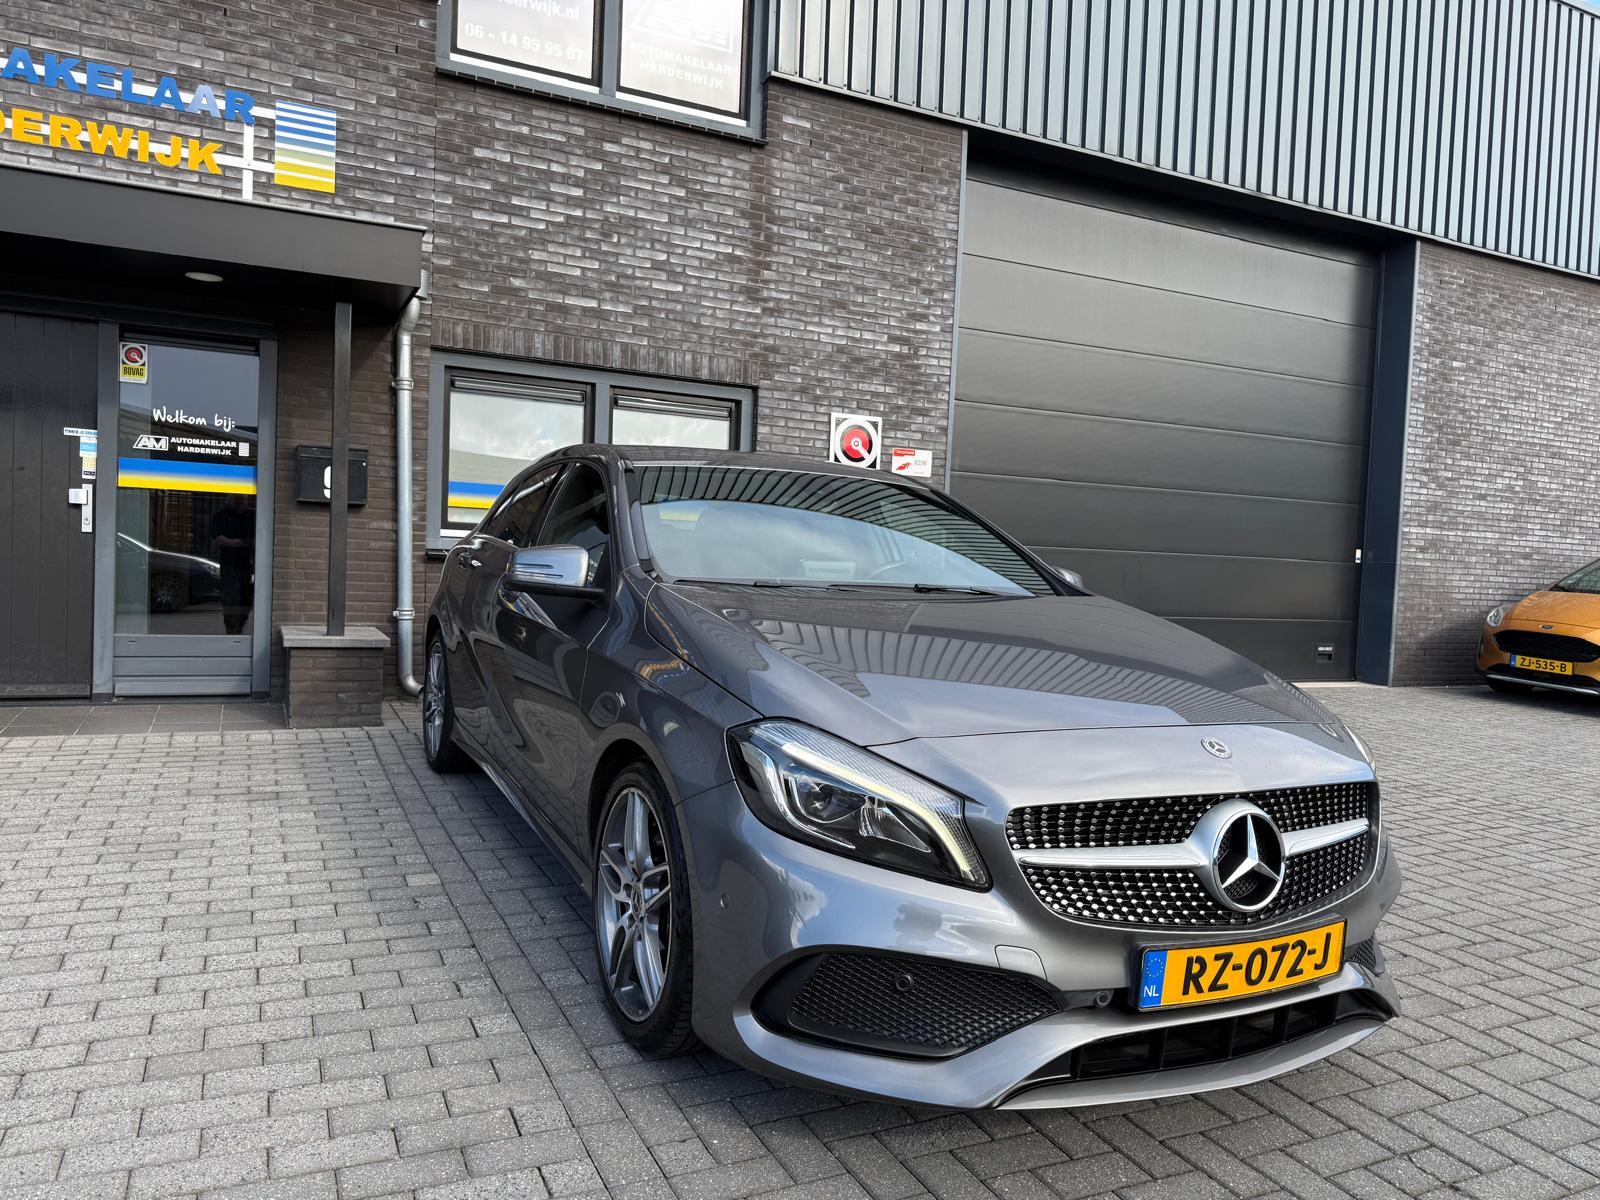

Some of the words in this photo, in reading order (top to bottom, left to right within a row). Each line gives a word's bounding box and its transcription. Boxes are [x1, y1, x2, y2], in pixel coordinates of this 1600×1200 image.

[464, 21, 485, 39] 06
[500, 30, 518, 48] 14
[522, 36, 541, 52] 95
[544, 41, 563, 57] 95
[566, 46, 584, 63] 67
[629, 42, 732, 75] AUTOMAKELAAR
[1, 48, 256, 127] AKELAAR
[639, 60, 724, 89] HARDERWIJK
[0, 108, 223, 176] ERWIJK
[123, 366, 144, 377] BOVAG
[152, 406, 207, 426] Welkom
[214, 413, 236, 432] bij:
[137, 436, 166, 449] AM
[170, 437, 237, 448] AUTOMAKELAAR
[177, 446, 232, 456] HARDERWIJK
[1520, 657, 1567, 673] ZJ-535-B
[1181, 932, 1333, 996] RZ-072-J
[1143, 985, 1159, 998] NL
